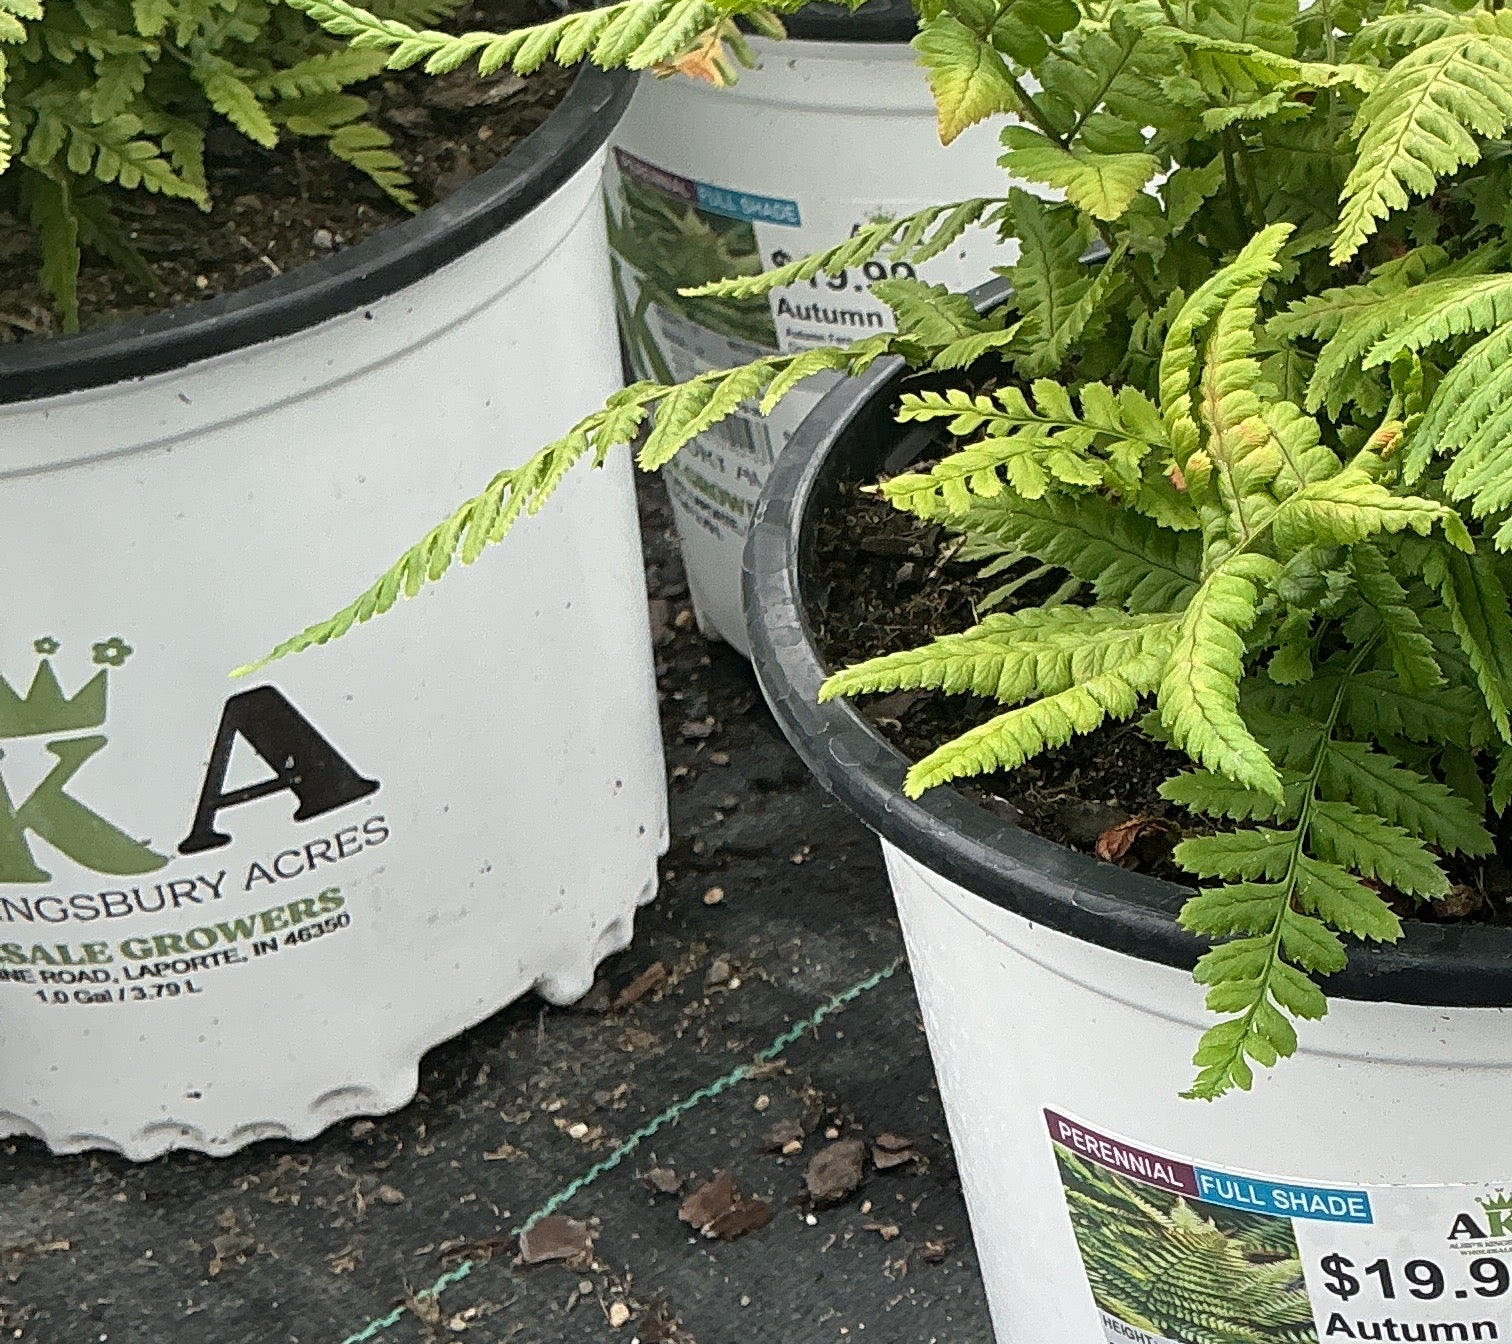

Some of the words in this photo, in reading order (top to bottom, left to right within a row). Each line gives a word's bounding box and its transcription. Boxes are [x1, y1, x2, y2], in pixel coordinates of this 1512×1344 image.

[777, 297, 884, 328] Autumn
[0, 869, 227, 924] NGSBURY
[245, 816, 390, 891] ACRES
[120, 887, 346, 961] GROWERS
[252, 935, 279, 957] IN
[283, 911, 352, 948] 46350
[73, 987, 113, 1005] Gal
[130, 982, 182, 1003] 3.79
[185, 978, 204, 995] L
[1058, 1120, 1184, 1188] PERENNIAL
[1201, 1173, 1267, 1206] FULL
[1273, 1189, 1368, 1218] SHADE
[1325, 1312, 1499, 1343] Autumn
